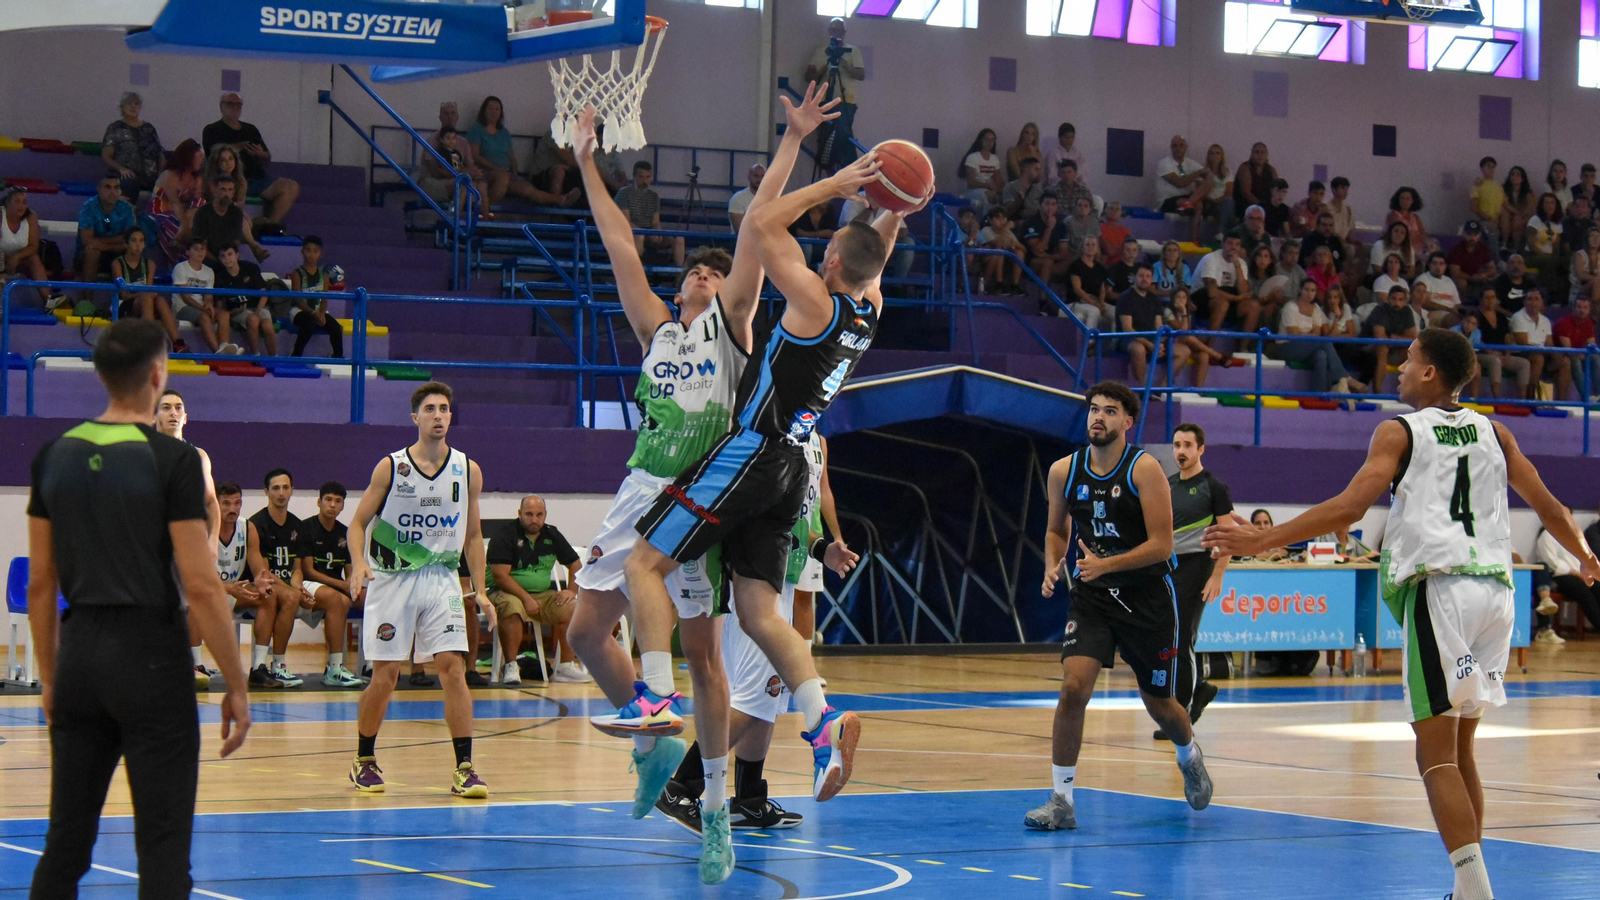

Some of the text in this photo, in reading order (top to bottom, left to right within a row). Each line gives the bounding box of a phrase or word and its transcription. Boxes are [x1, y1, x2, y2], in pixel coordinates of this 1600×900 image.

[653, 358, 717, 380] GROW
[649, 383, 675, 400] UP
[452, 481, 460, 503] 8
[1449, 454, 1476, 538] 4
[1093, 500, 1106, 518] 18
[398, 512, 460, 528] GROW
[397, 530, 423, 544] UP
[425, 528, 456, 538] Capital
[276, 546, 289, 566] 91
[326, 552, 333, 569] 2
[1220, 588, 1328, 621] deportes
[1151, 669, 1167, 687] 18
[1456, 667, 1473, 680] UP
